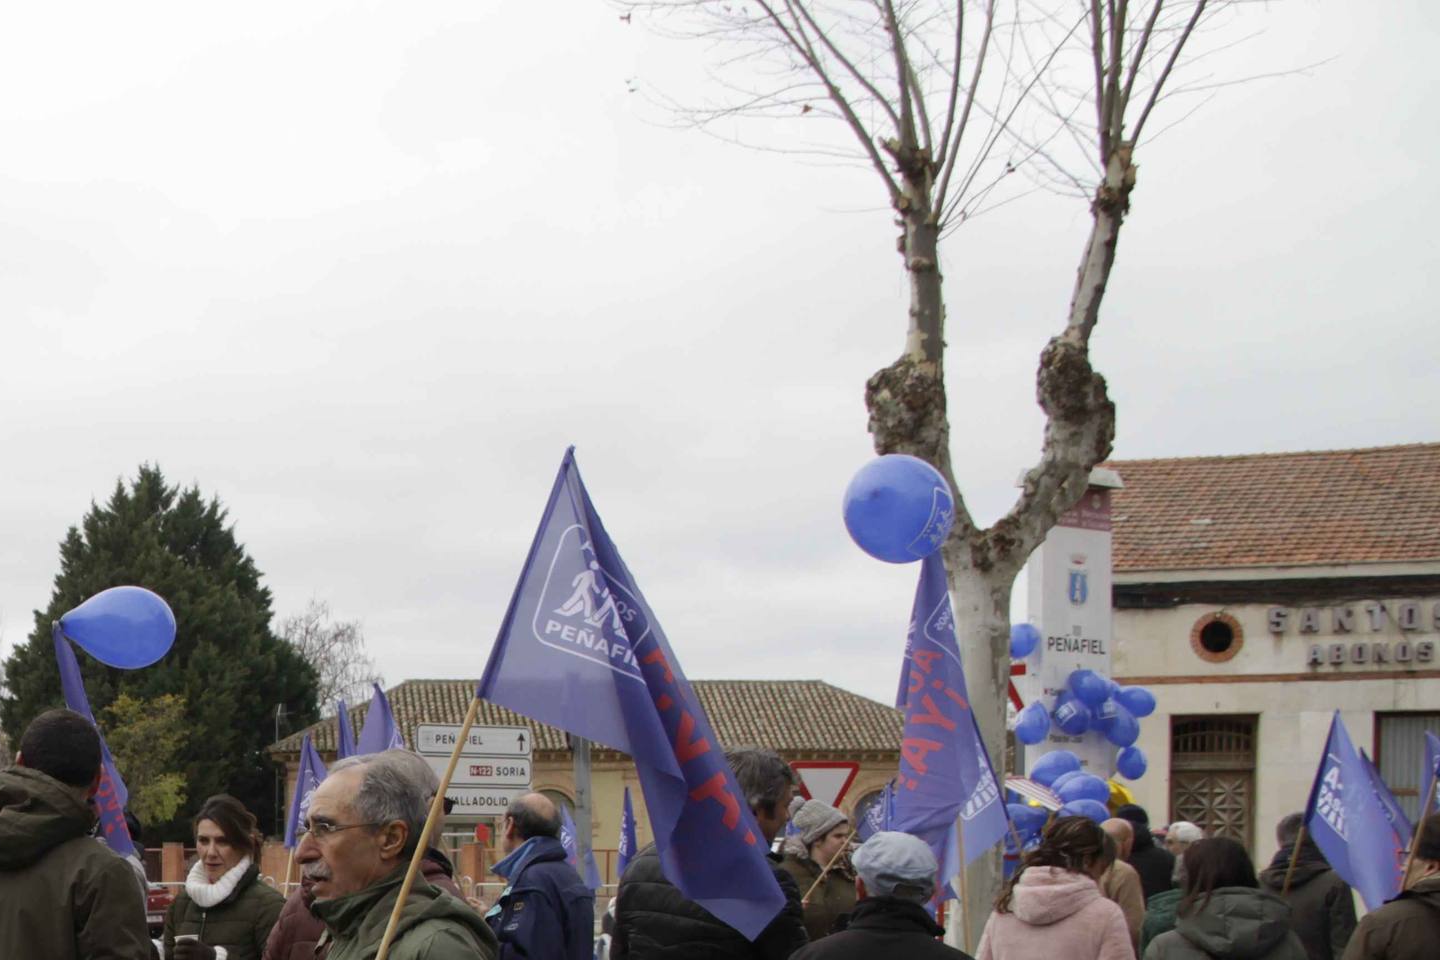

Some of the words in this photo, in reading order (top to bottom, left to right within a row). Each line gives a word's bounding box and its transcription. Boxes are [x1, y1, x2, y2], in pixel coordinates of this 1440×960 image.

[1047, 633, 1106, 655] PEÑAFIEL
[1307, 641, 1434, 667] ABONOS
[435, 733, 484, 746] PEÑIEL
[495, 766, 526, 777] SORIA
